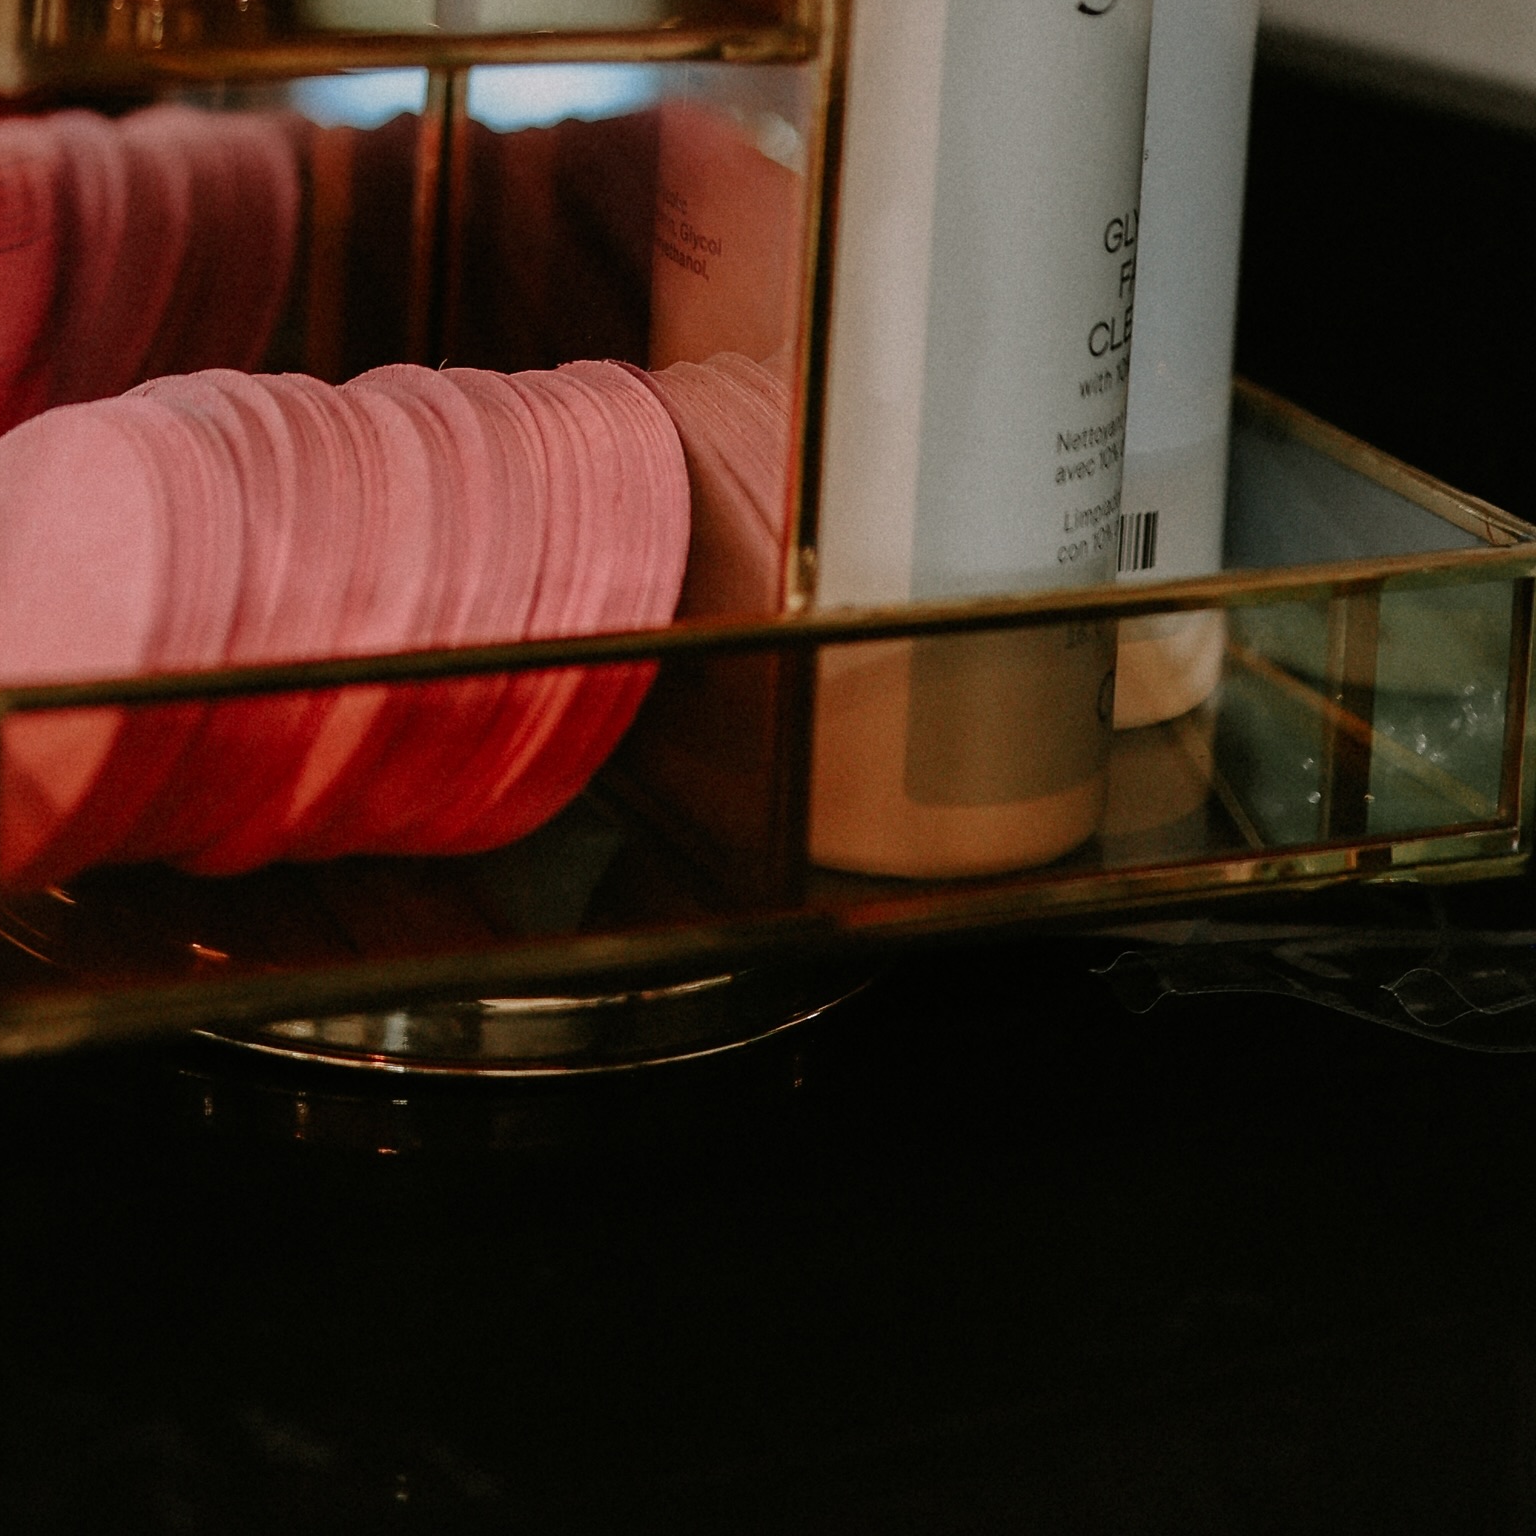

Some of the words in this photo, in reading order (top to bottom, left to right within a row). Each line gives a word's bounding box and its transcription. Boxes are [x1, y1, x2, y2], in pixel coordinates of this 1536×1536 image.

[679, 222, 722, 257] Glycol
[1054, 458, 1096, 487] avec
[1056, 539, 1089, 565] con
